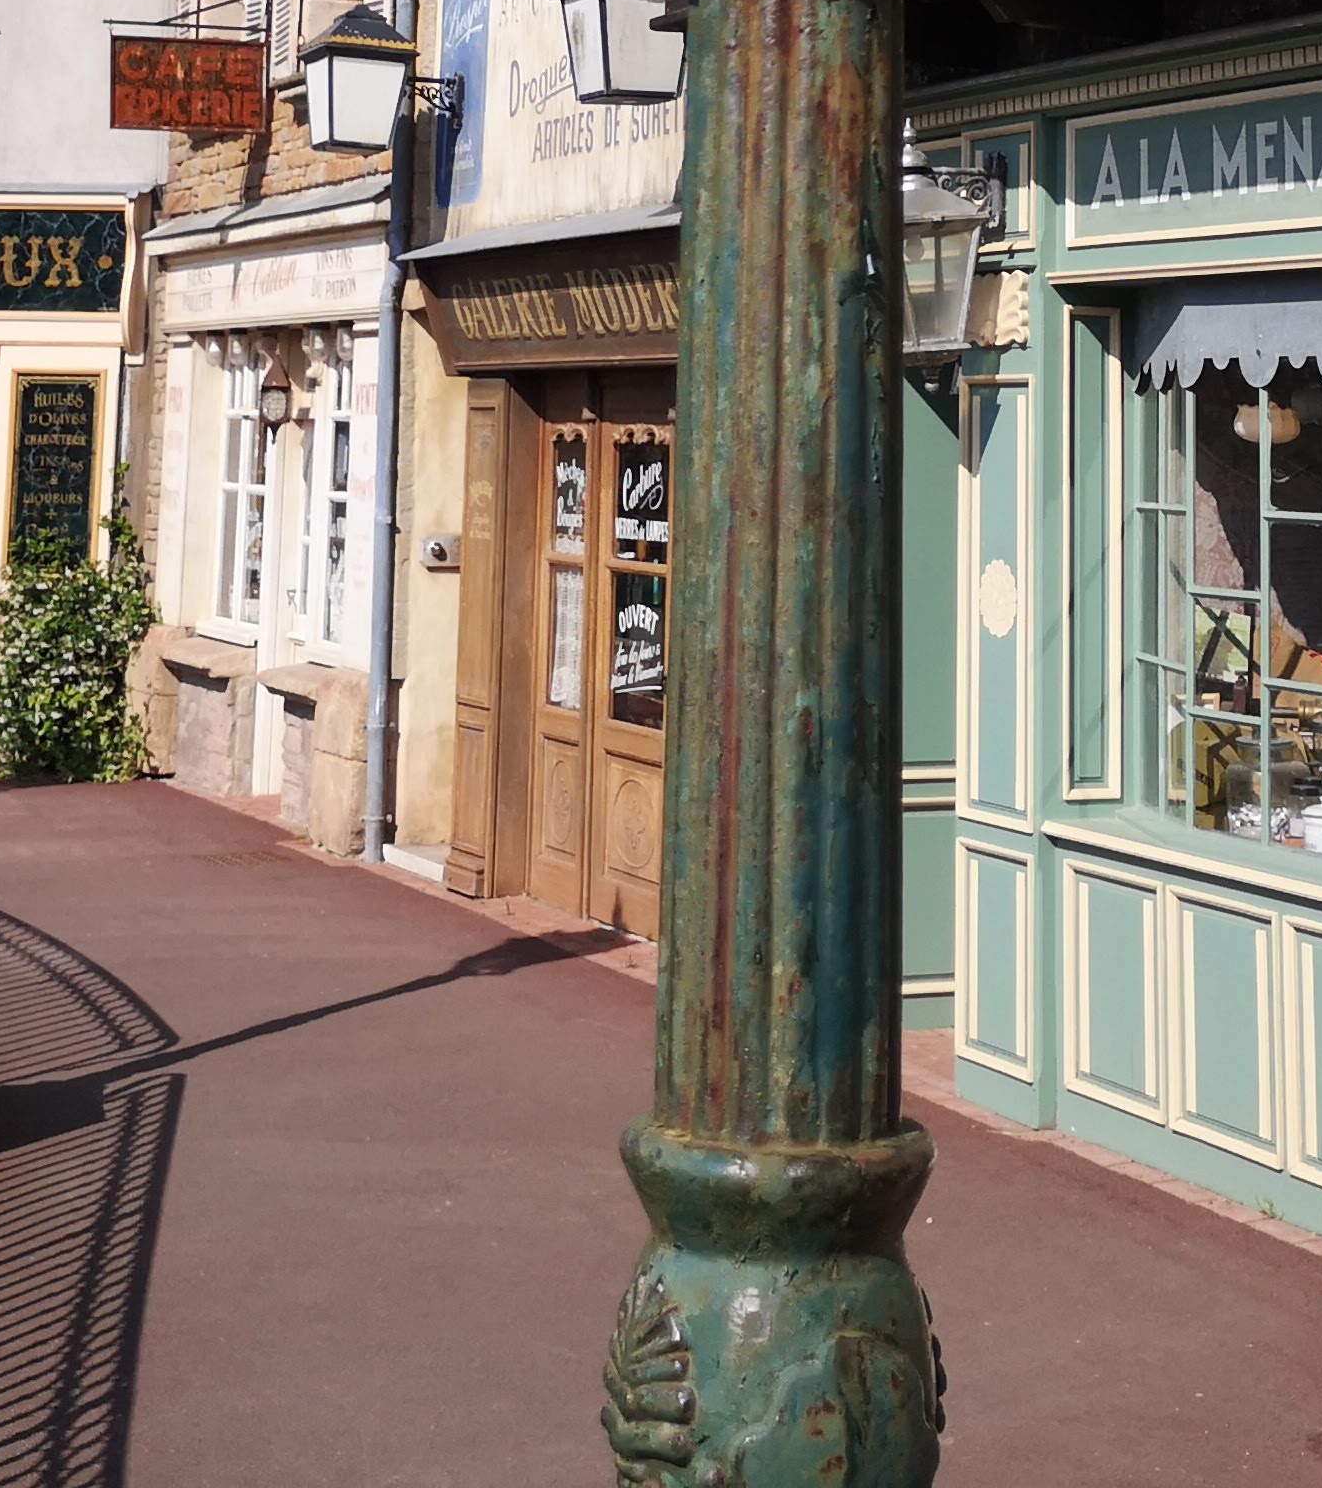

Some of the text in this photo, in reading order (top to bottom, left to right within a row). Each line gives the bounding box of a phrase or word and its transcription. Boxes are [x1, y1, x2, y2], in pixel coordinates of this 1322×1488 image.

[119, 44, 255, 85] CAFE
[510, 54, 574, 117] Drogue
[115, 86, 261, 127] EPICERIE
[533, 100, 686, 163] ARTICLES DE SURET
[1091, 133, 1124, 209] A
[1139, 127, 1191, 205] LA
[452, 262, 680, 340] GALERIE MODER
[623, 461, 663, 512] Carbure
[619, 603, 659, 636] OUVERT
